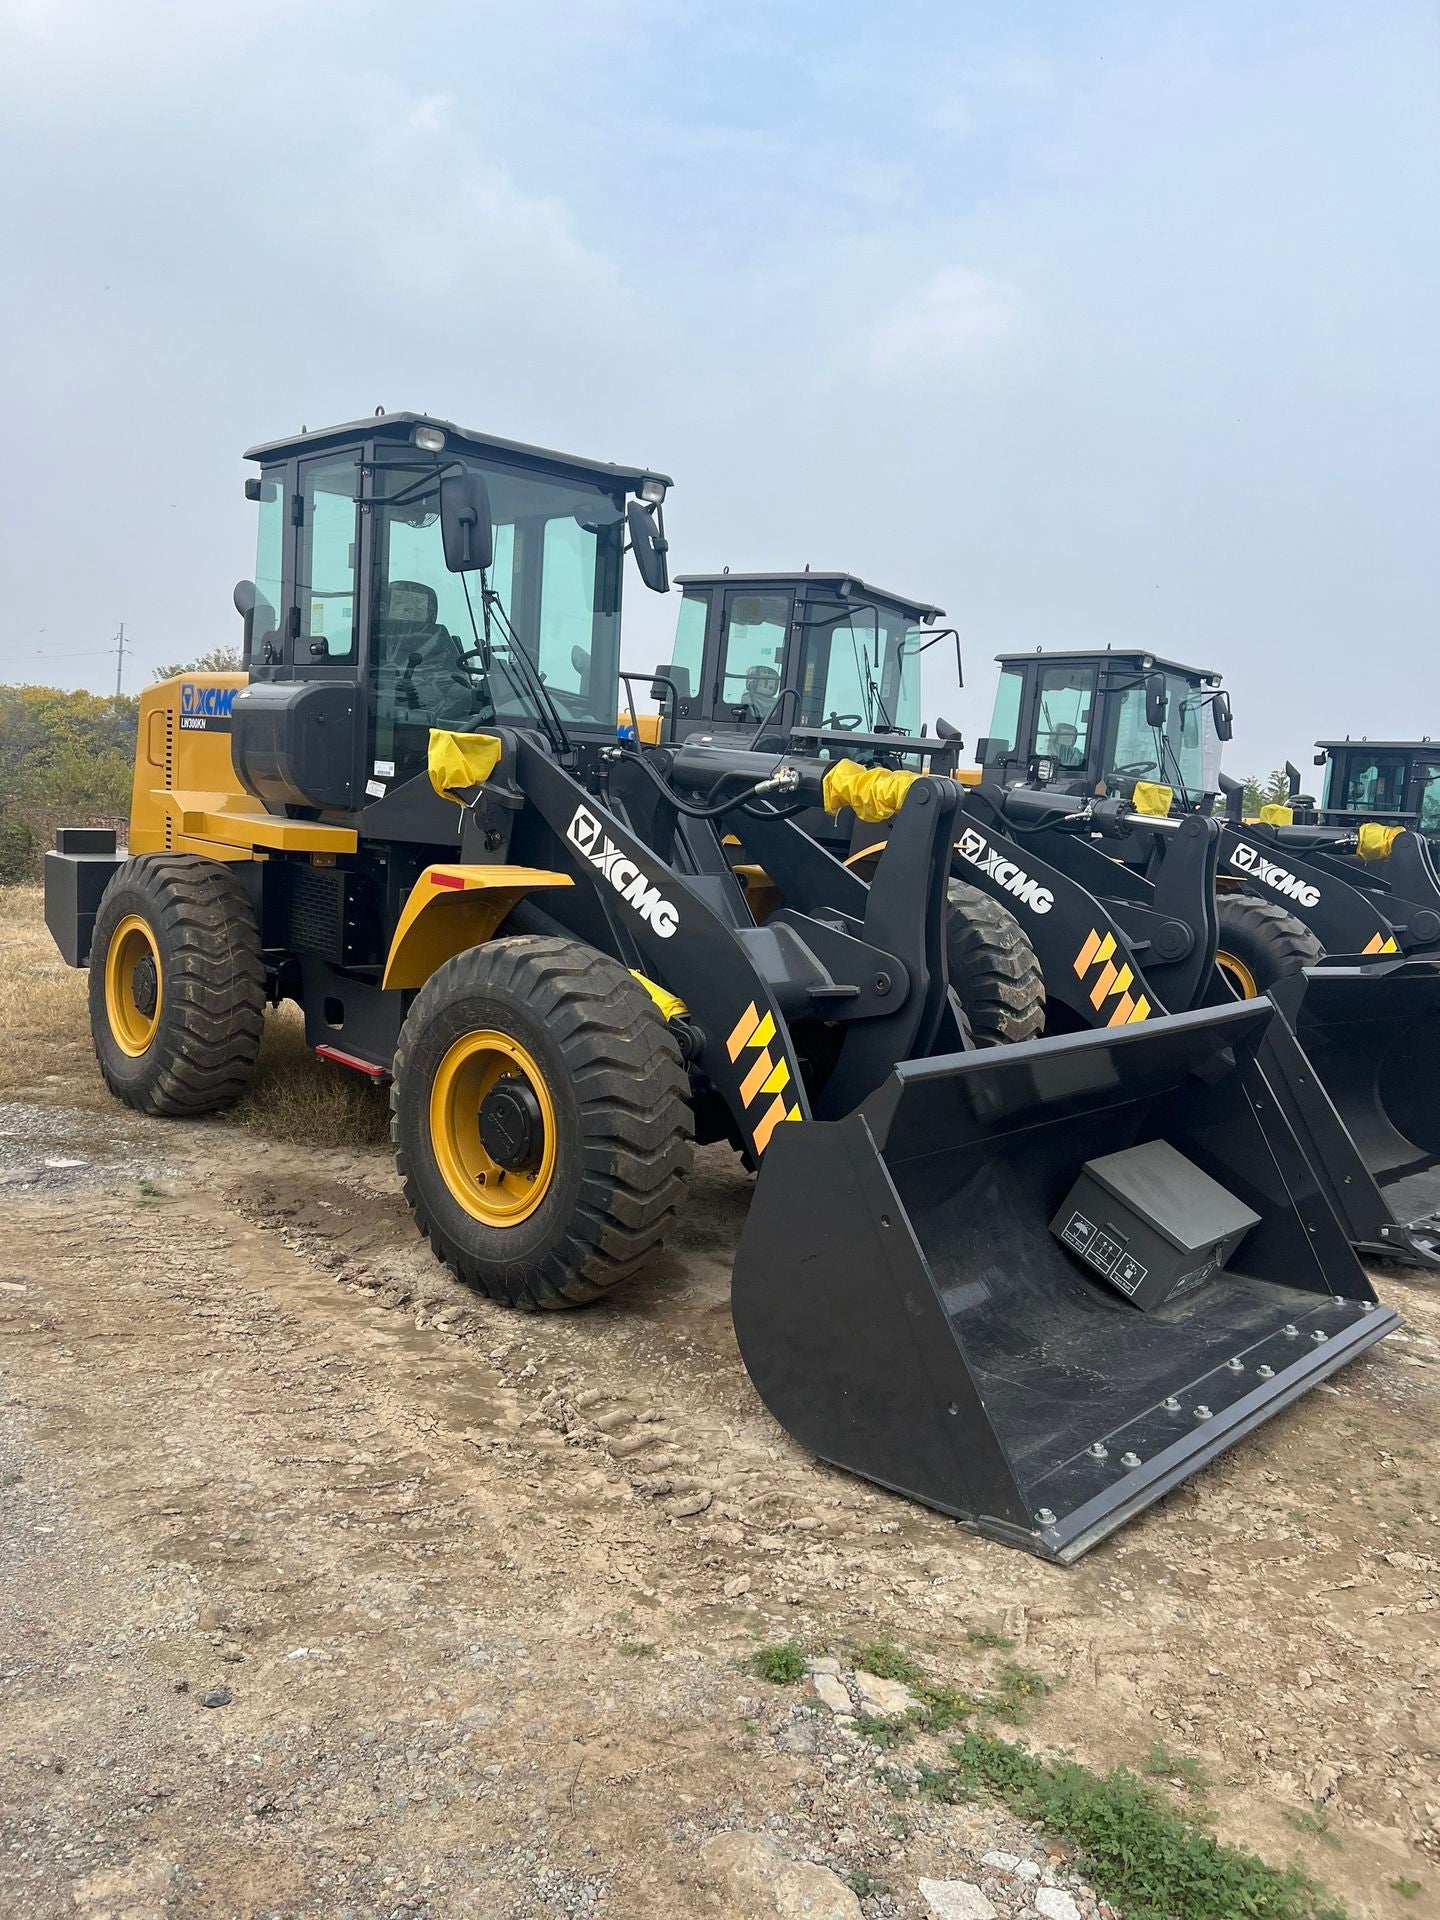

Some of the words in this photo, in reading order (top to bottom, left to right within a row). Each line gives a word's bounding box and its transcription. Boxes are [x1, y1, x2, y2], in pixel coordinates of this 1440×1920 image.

[180, 717, 207, 729] LW300KN
[587, 835, 680, 938] XCMG
[974, 847, 1055, 914] XCMG
[1248, 856, 1321, 908] XCMG
